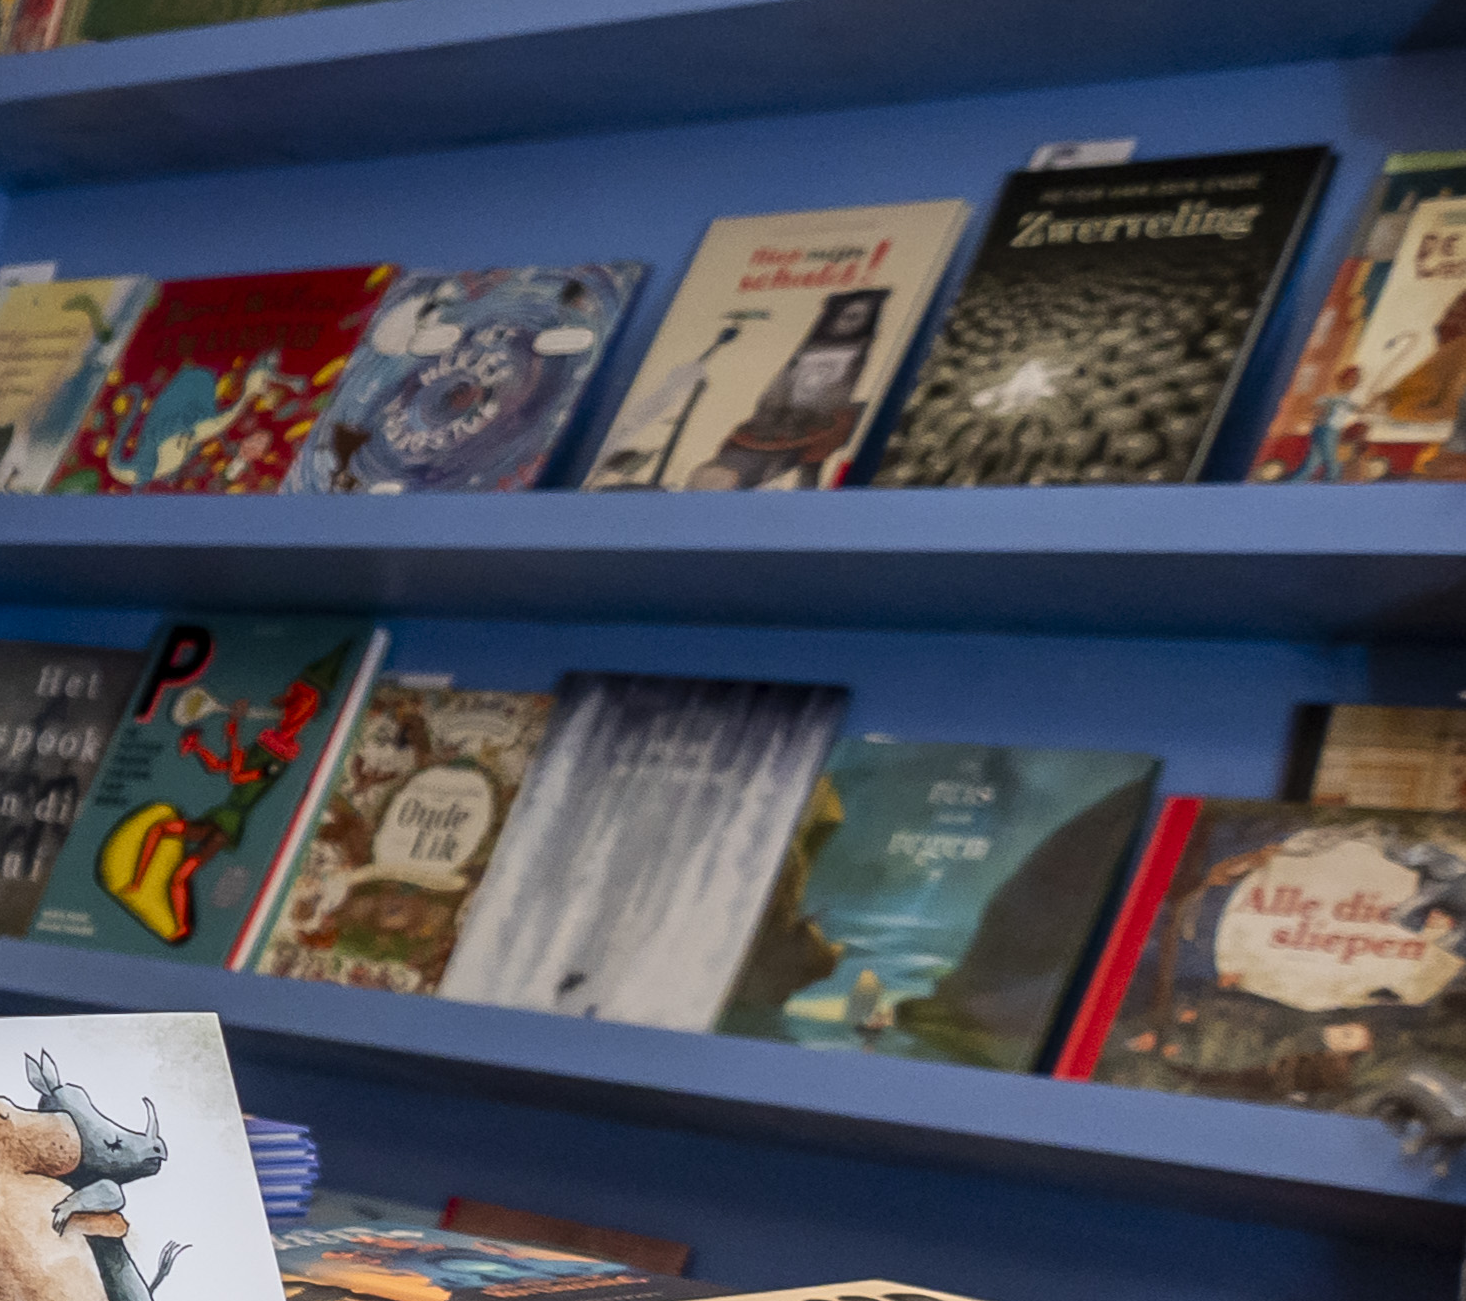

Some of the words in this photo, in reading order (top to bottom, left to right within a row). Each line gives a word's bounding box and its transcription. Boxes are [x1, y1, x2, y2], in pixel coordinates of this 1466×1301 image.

[1009, 200, 1265, 248] Zwerveling
[35, 663, 103, 701] Het
[397, 798, 470, 829] Oude
[408, 826, 459, 862] Eik
